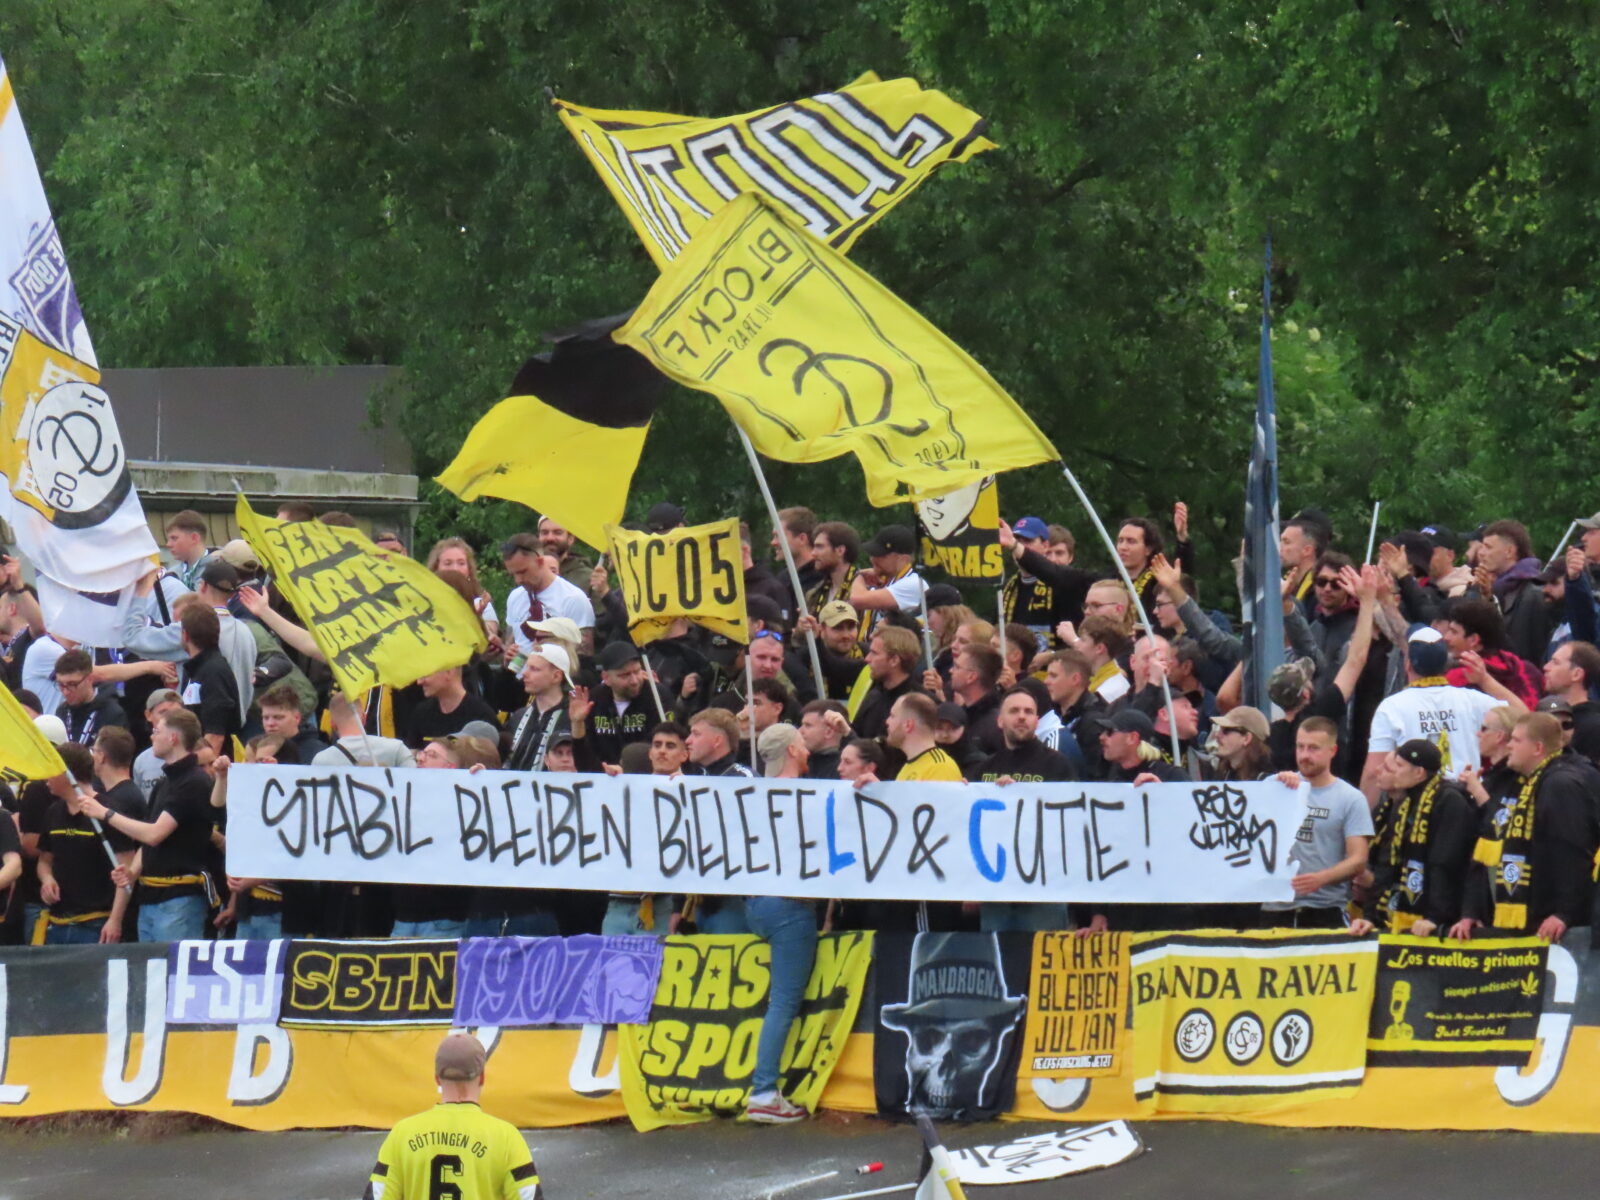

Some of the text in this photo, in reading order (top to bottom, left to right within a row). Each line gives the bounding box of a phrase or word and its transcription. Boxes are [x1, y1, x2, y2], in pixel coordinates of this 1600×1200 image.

[314, 582, 434, 660] UERILLA
[906, 803, 951, 883] &
[653, 933, 862, 1011] RASN
[1041, 933, 1121, 970] STARK
[1386, 948, 1540, 973] Los cuellos gritando
[290, 951, 457, 1011] SBTN
[458, 935, 609, 1024] 1907
[1038, 971, 1118, 1012] BLEIBEN
[1136, 962, 1358, 1006] BANDA RAVAL
[1034, 1013, 1117, 1053] JULIAN
[408, 1131, 489, 1158] GÖTTINGEN 05
